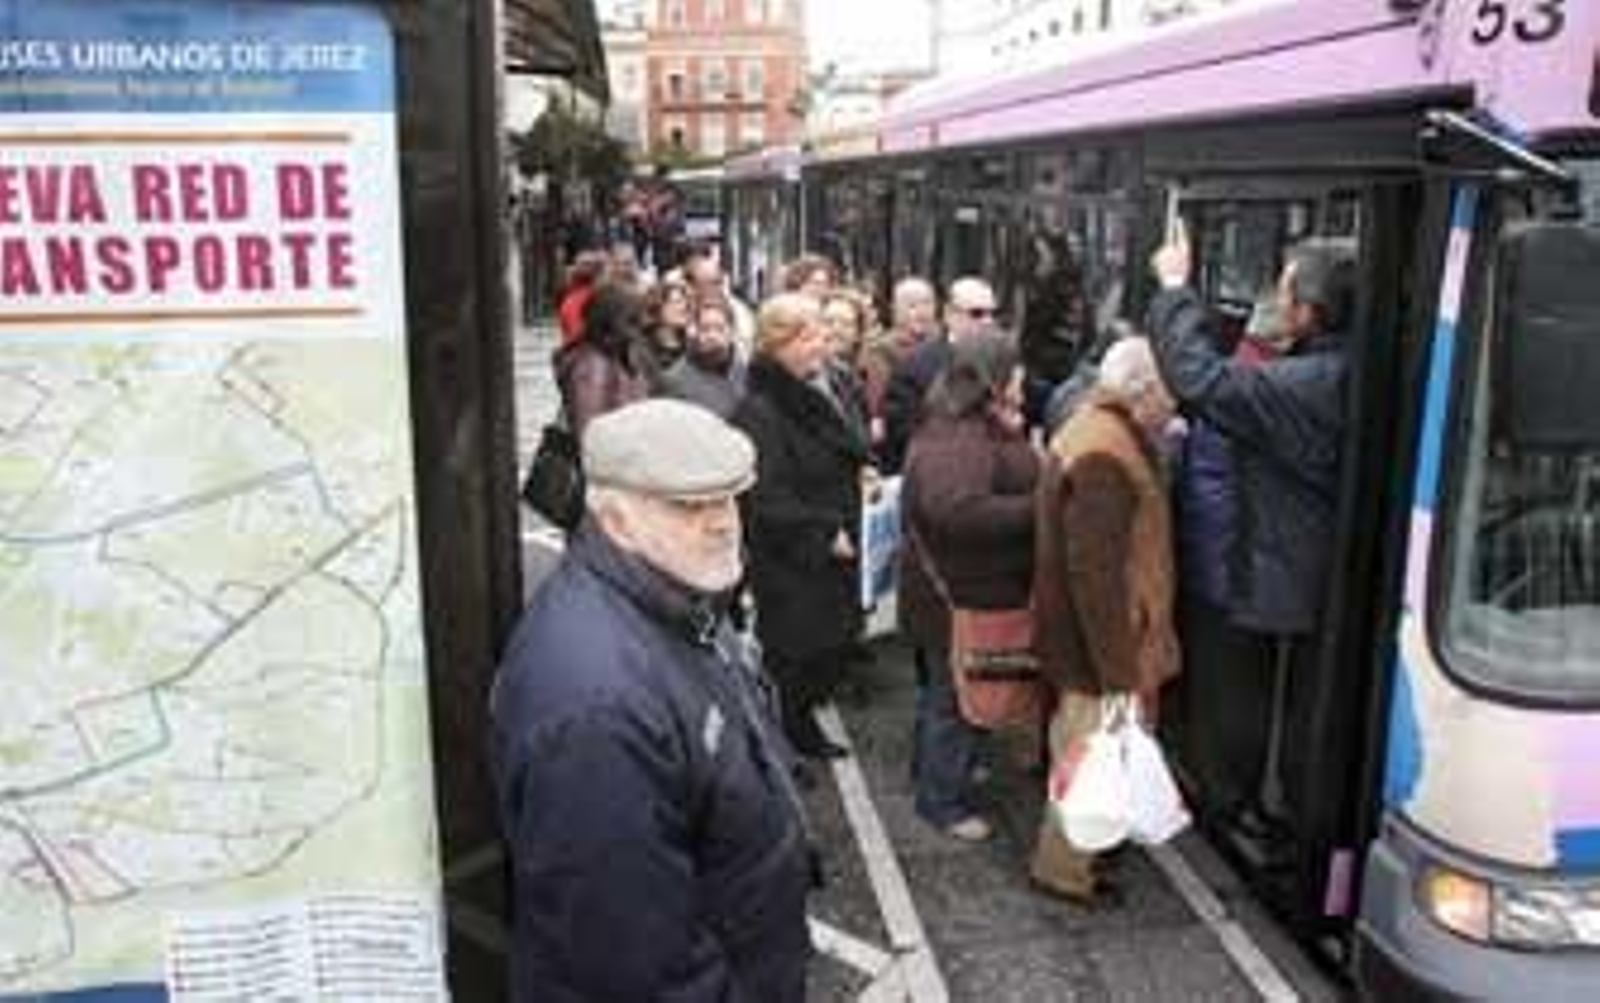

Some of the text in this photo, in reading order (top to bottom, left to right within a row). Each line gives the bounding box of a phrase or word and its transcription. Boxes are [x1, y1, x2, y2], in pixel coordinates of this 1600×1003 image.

[1472, 0, 1565, 46] 53
[73, 41, 224, 71] URBANOS
[231, 43, 272, 70] DE
[279, 44, 366, 71] JEREZ
[0, 163, 352, 223] EVA RED DE
[2, 234, 356, 295] ANSPORTE
